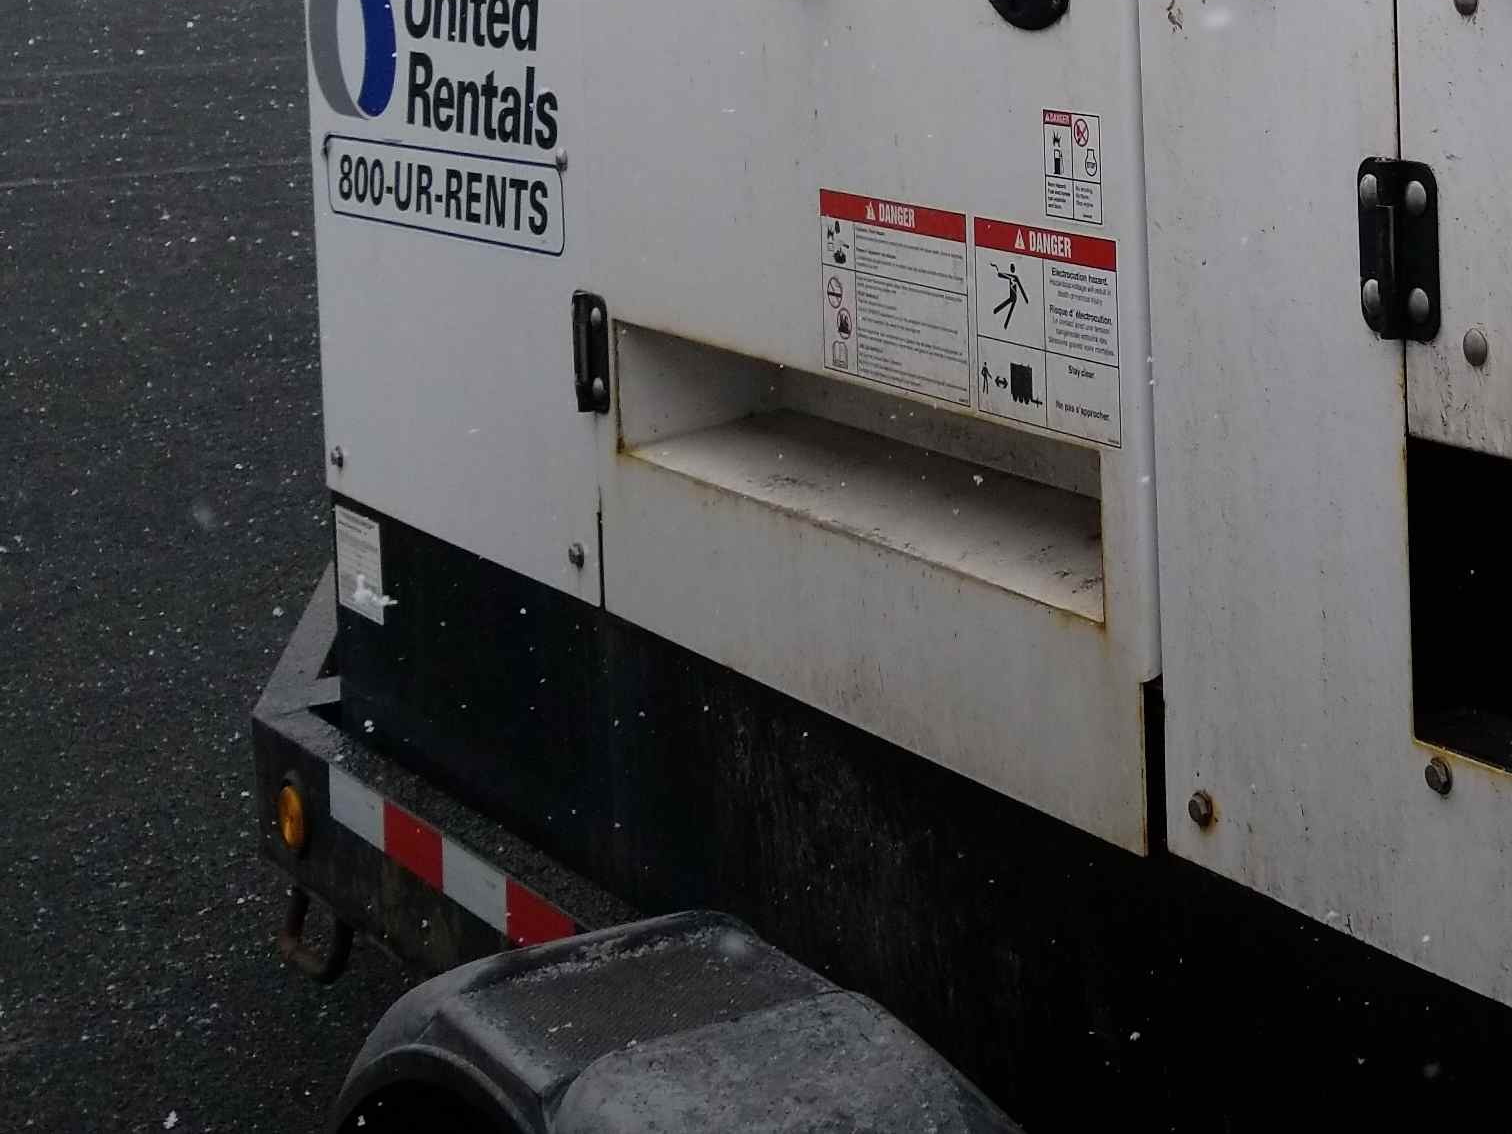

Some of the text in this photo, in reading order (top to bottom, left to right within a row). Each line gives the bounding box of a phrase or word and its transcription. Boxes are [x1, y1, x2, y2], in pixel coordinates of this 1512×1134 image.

[407, 51, 558, 149] Rentals
[338, 154, 548, 235] 800-UR-RENTS
[878, 202, 916, 228] DANGER
[1029, 230, 1073, 259] DANGER
